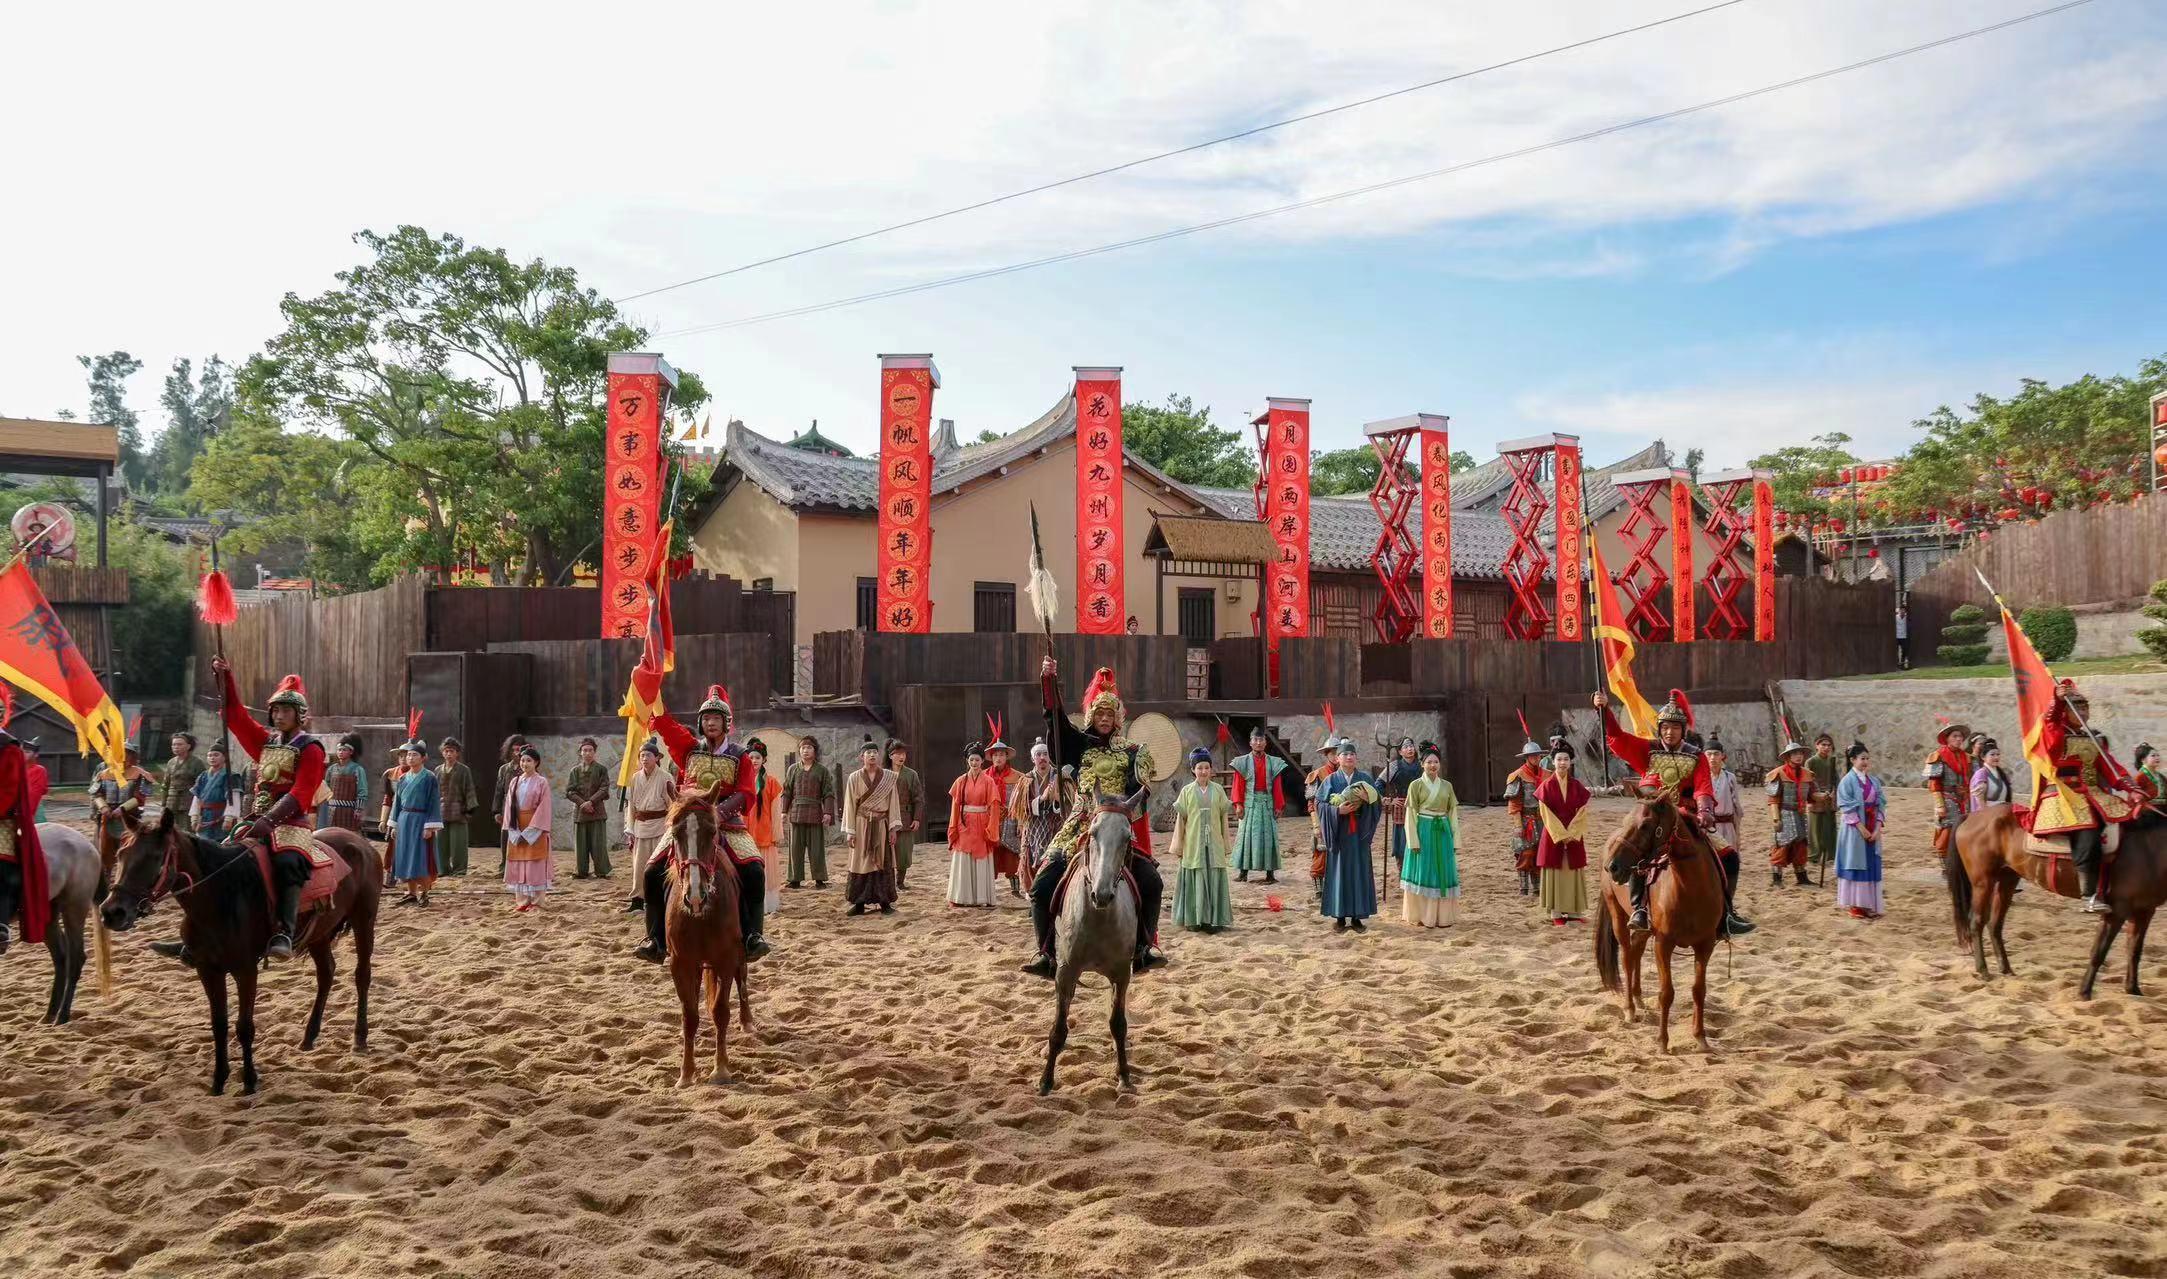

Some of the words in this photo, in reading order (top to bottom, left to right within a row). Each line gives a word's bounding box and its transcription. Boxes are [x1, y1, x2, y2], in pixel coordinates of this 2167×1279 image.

[890, 396, 918, 628] 一帆风顺年年好
[1088, 396, 1110, 618] 花好九州岁月香
